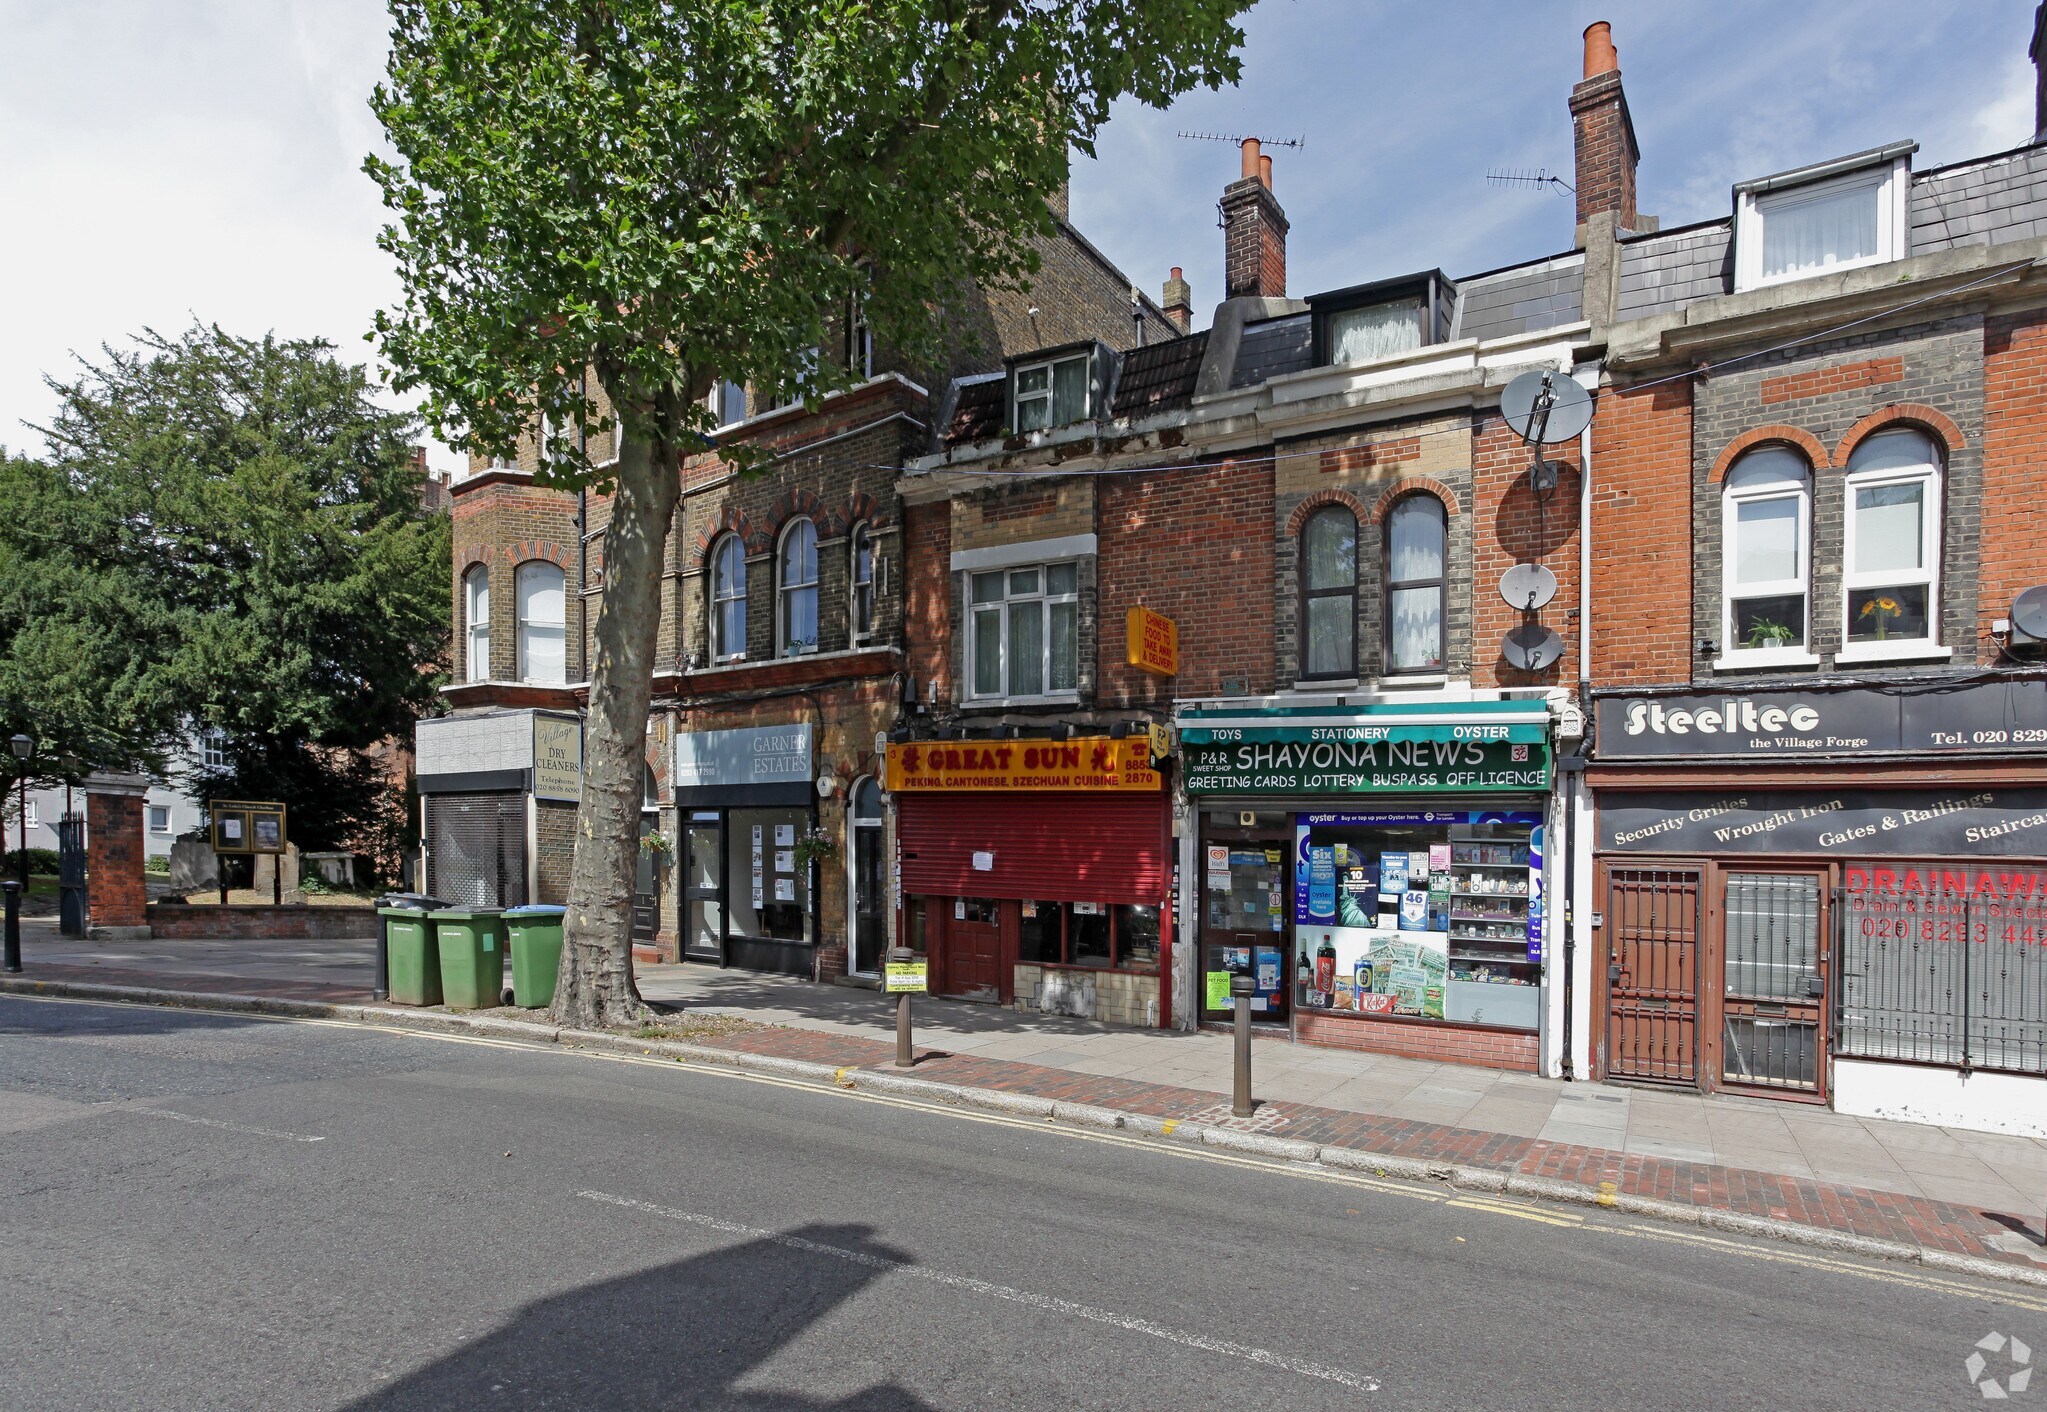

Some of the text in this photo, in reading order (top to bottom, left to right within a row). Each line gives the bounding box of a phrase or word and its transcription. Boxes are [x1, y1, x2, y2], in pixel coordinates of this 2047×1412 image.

[1146, 614, 1169, 633] CHINESE
[1146, 626, 1170, 646] FOOD TO
[1144, 638, 1172, 658] TAKE AWAY
[1149, 652, 1174, 670] DELIVERY
[1624, 698, 1820, 736] Steeltec
[538, 723, 574, 745] Village
[1212, 730, 1242, 740] TOYS
[1312, 728, 1390, 740] STATIONERY
[1453, 726, 1509, 738] OYSTER
[1931, 730, 2047, 744] Tel. 020 829
[754, 734, 806, 752] GARNER
[1750, 736, 1868, 750] the Village Forge
[548, 748, 566, 760] DRY
[890, 750, 896, 760] 3
[928, 748, 1012, 770] GREAT
[1024, 746, 1080, 770] SUN
[1236, 740, 1484, 770] SHAYONA NEWS
[536, 758, 580, 773] CLEANERS
[754, 756, 806, 774] ESTATES
[540, 776, 575, 786] Telephone
[1013, 776, 1070, 787] SZECHUAN
[1074, 776, 1118, 786] CUISINE
[1126, 772, 1152, 784] 2870
[1188, 770, 1546, 788] GREETING CARDS LOTTERY BUSPASS OFF LICENCE
[1310, 813, 1335, 824] oyster
[1615, 797, 1748, 846] Security Grilles
[1713, 800, 1844, 843] Wrought Iron
[1818, 792, 1994, 847] Gates & Railings
[1965, 812, 2047, 843] Stairca
[1312, 848, 1332, 860] Six
[1350, 870, 1363, 880] 10
[1846, 868, 2047, 900] DRAINAW
[1406, 892, 1423, 904] 46
[1854, 898, 1898, 912] Drain
[1906, 900, 1916, 912] &
[1924, 900, 1980, 915] Sewer
[1862, 918, 1908, 939] 020
[1921, 920, 1988, 942] 8293
